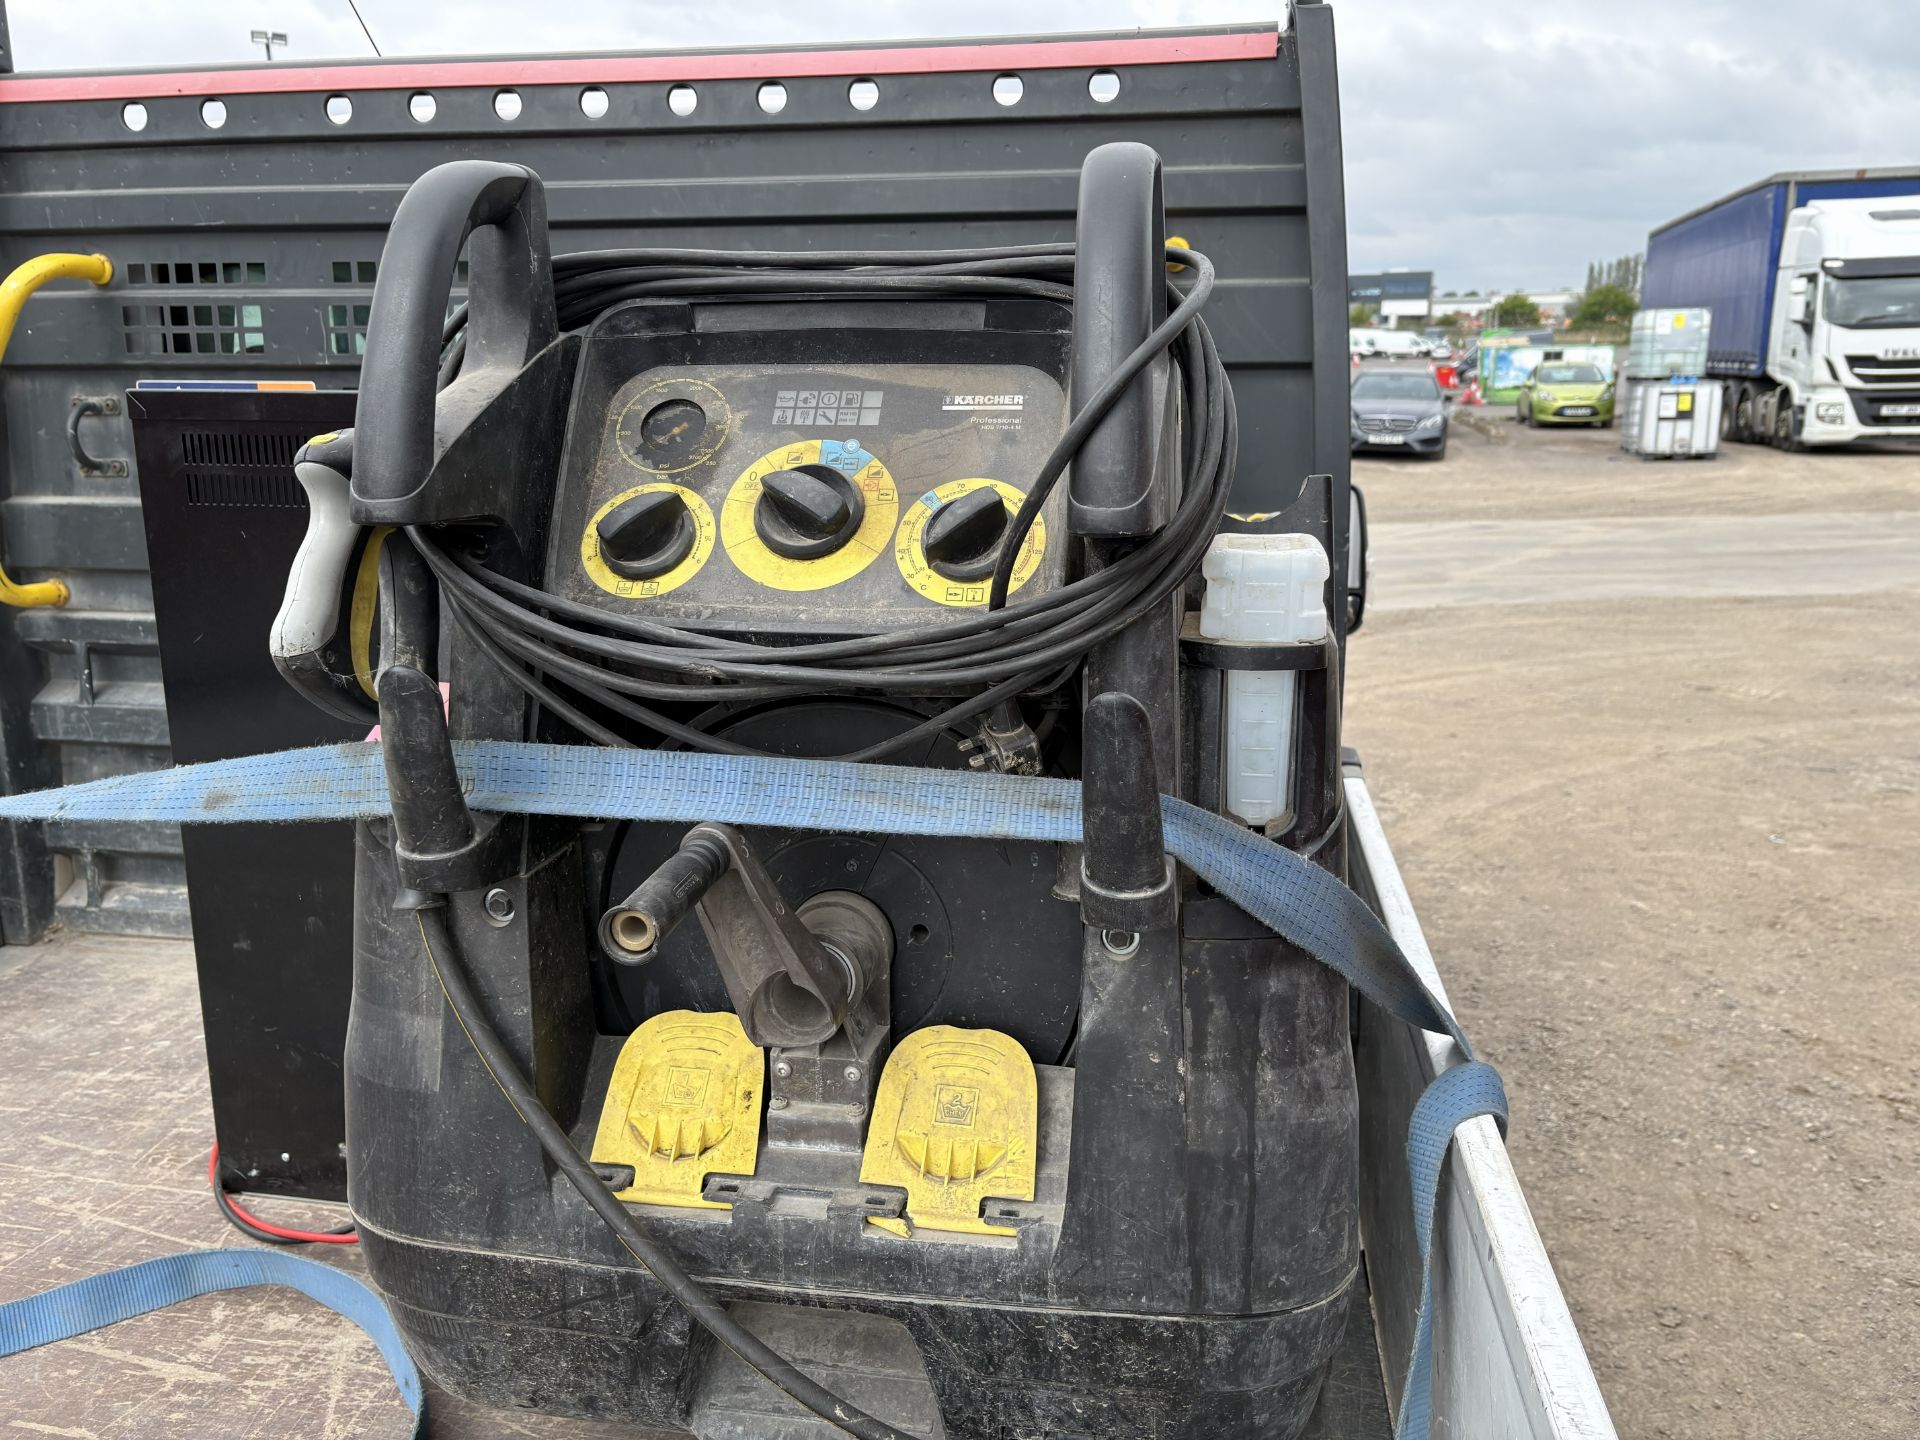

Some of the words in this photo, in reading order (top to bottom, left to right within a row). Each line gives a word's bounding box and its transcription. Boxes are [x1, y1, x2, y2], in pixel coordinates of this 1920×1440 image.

[954, 395, 1024, 405] KÄRCHER
[970, 416, 1022, 424] Professional
[749, 471, 758, 482] 0
[952, 1093, 962, 1105] 2
